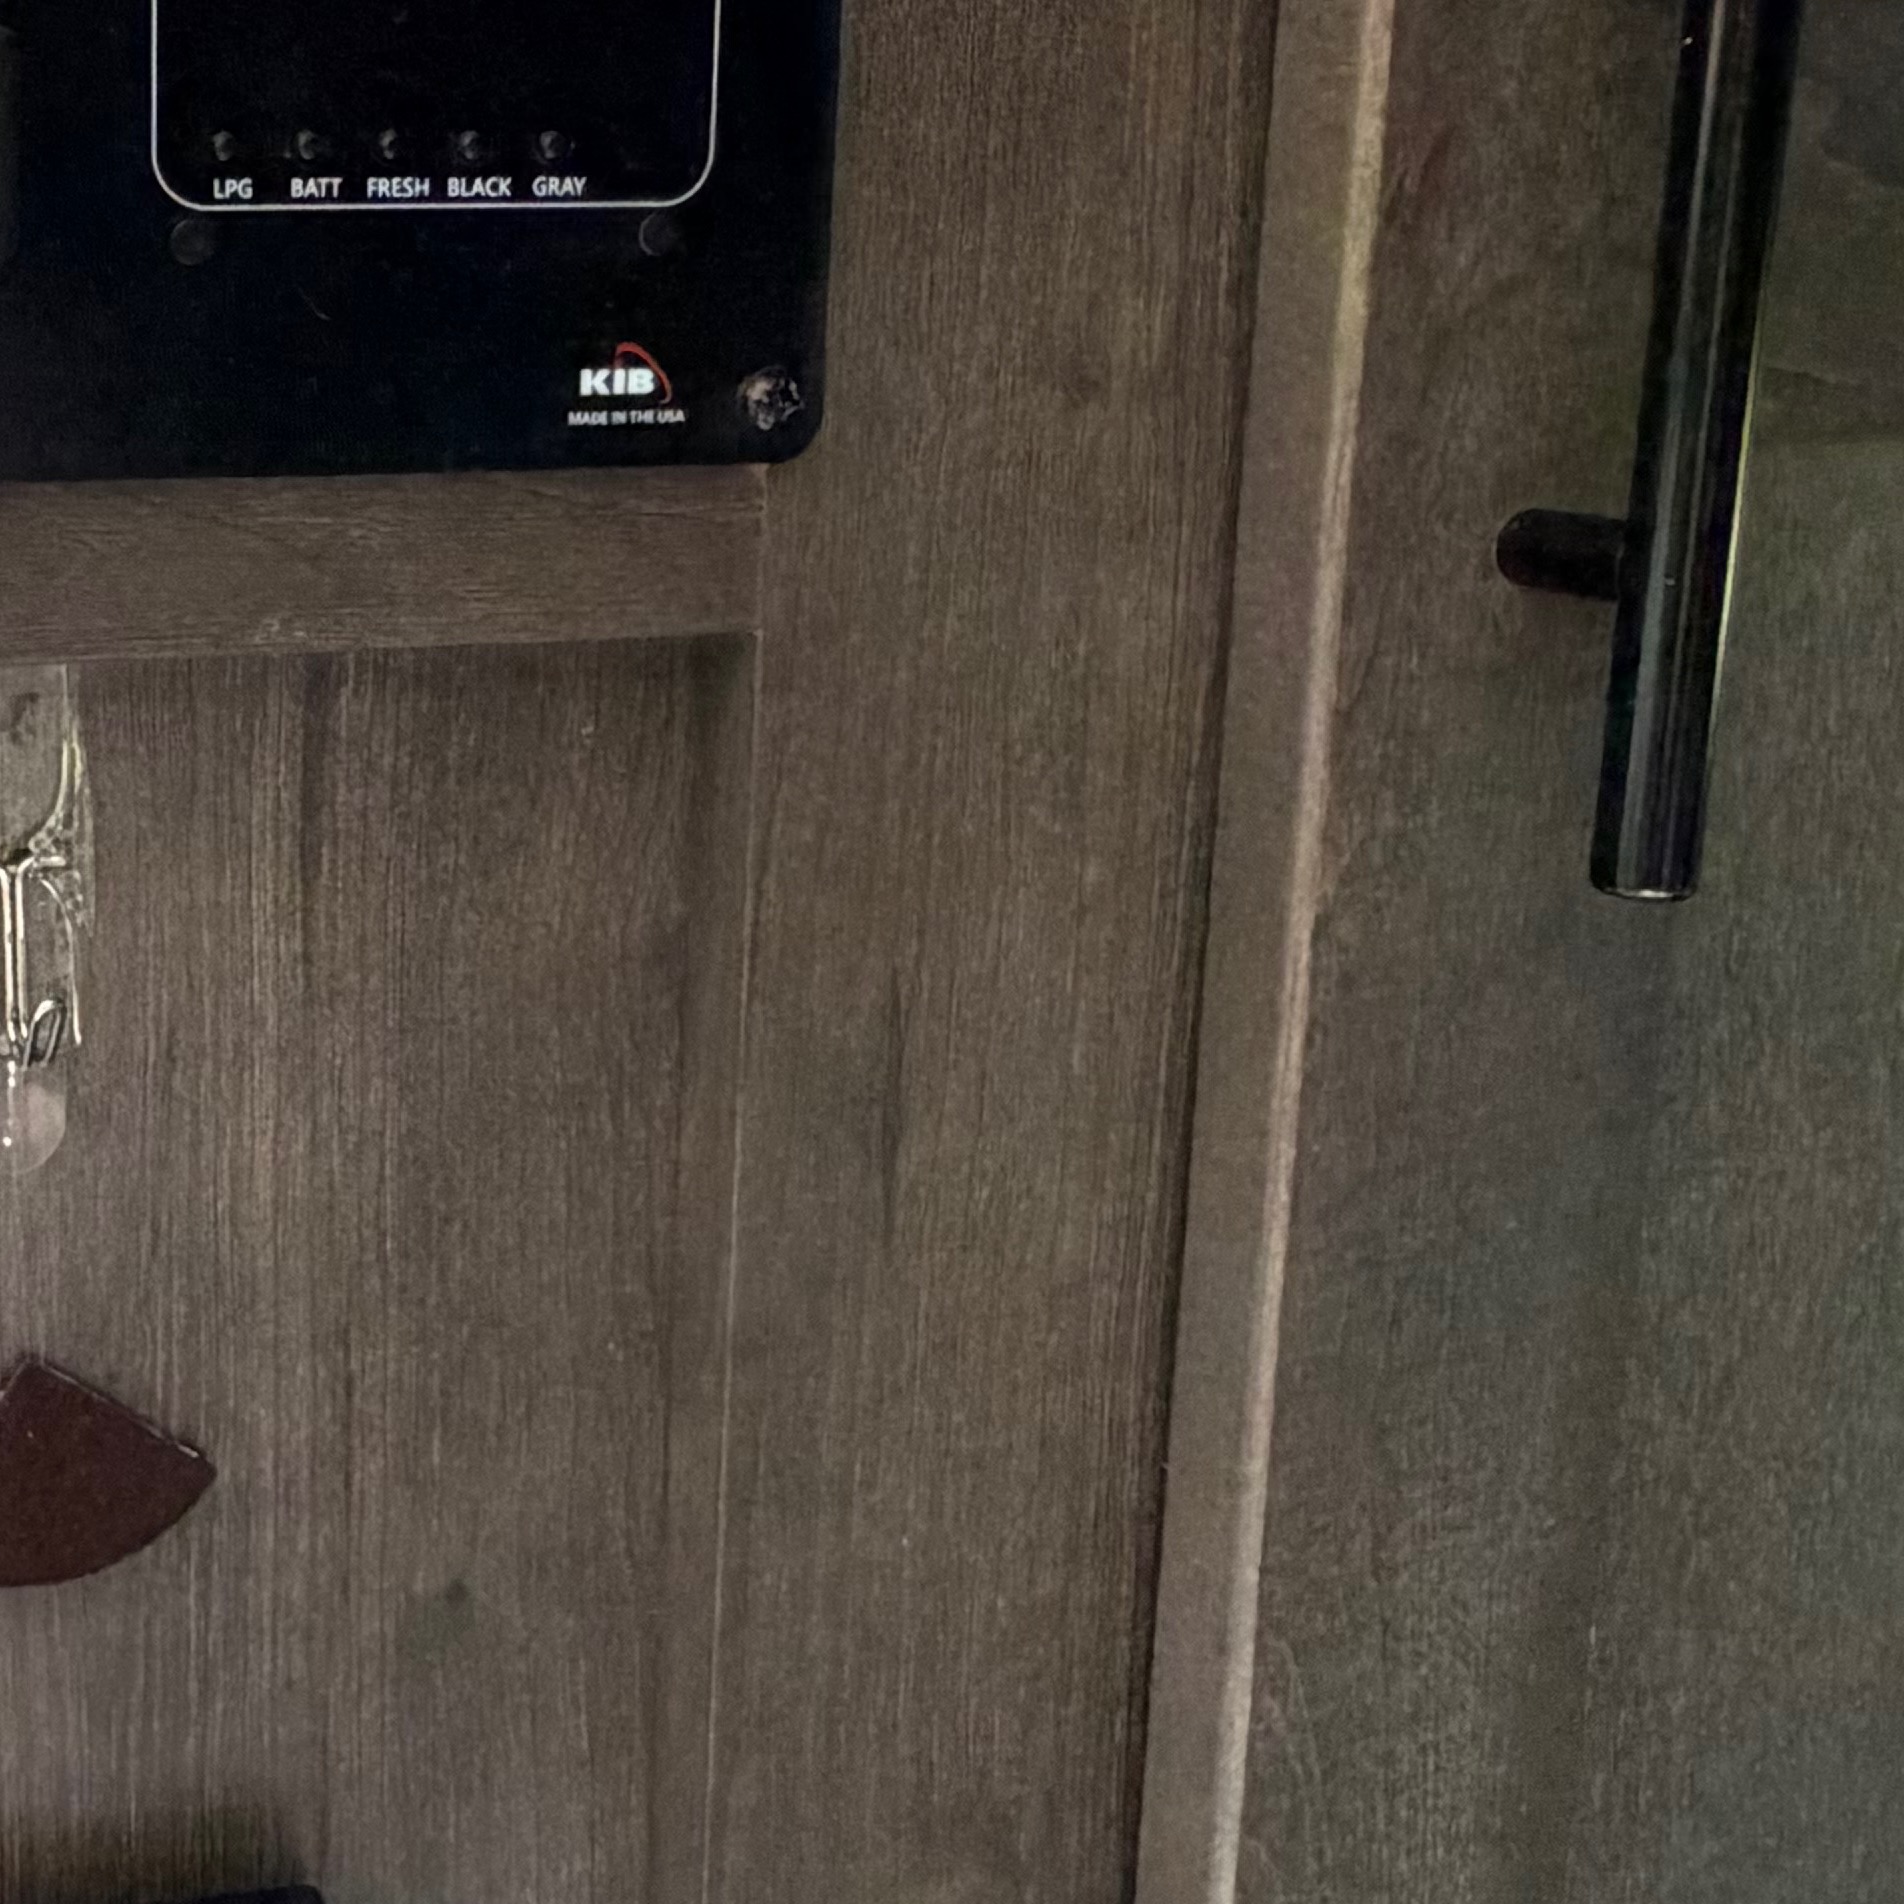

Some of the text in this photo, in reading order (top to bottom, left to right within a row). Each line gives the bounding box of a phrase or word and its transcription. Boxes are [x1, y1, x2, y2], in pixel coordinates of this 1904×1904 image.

[212, 175, 587, 200] LPG BATT FRESH BLACK GRAY
[579, 367, 655, 396] KIB
[567, 408, 686, 426] MADE IN THE USA
